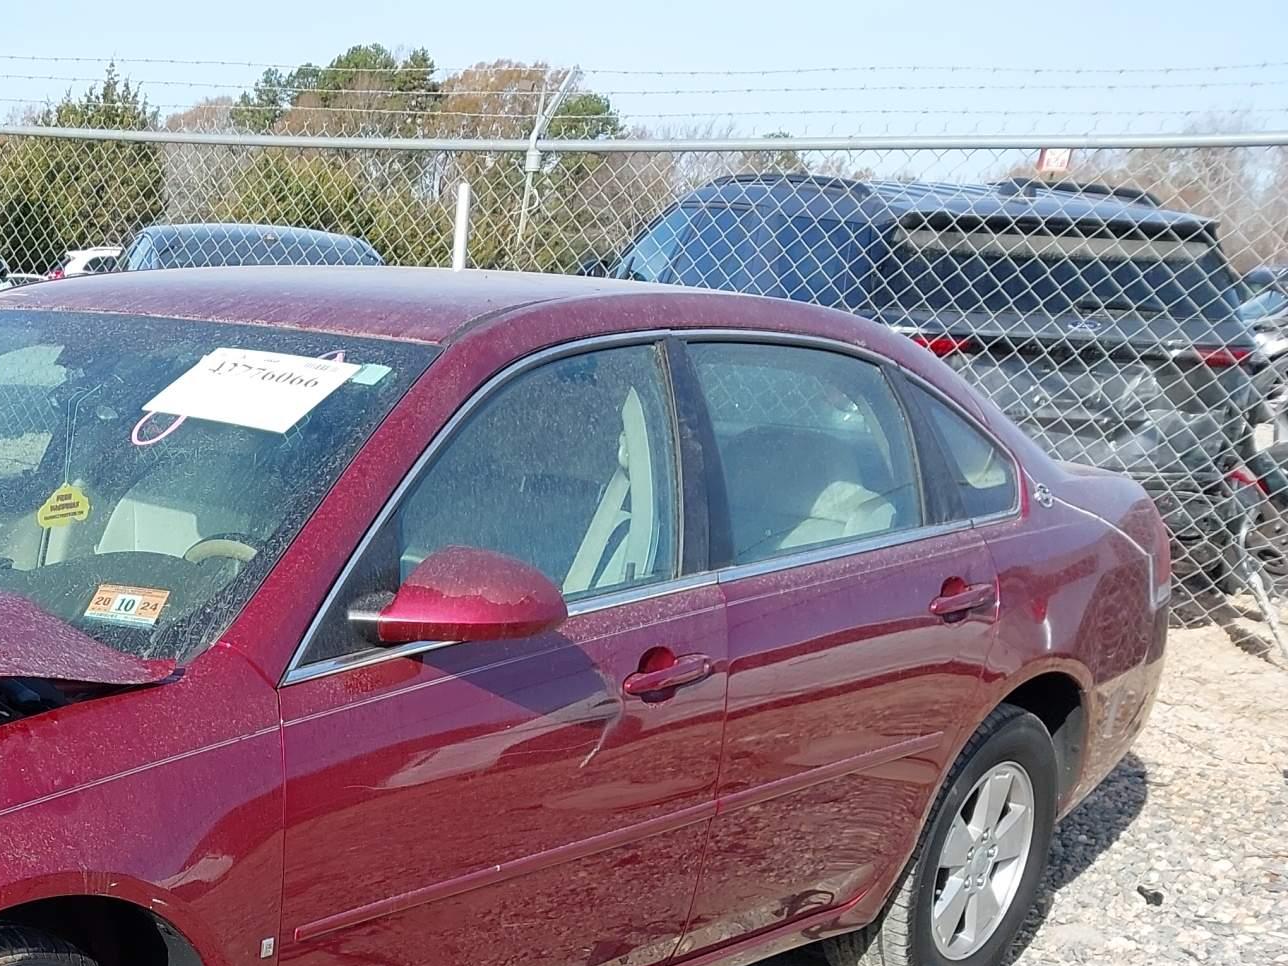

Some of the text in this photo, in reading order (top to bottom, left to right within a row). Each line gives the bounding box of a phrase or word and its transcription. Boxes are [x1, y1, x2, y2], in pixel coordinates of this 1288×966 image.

[94, 596, 159, 612] 20 10 24
